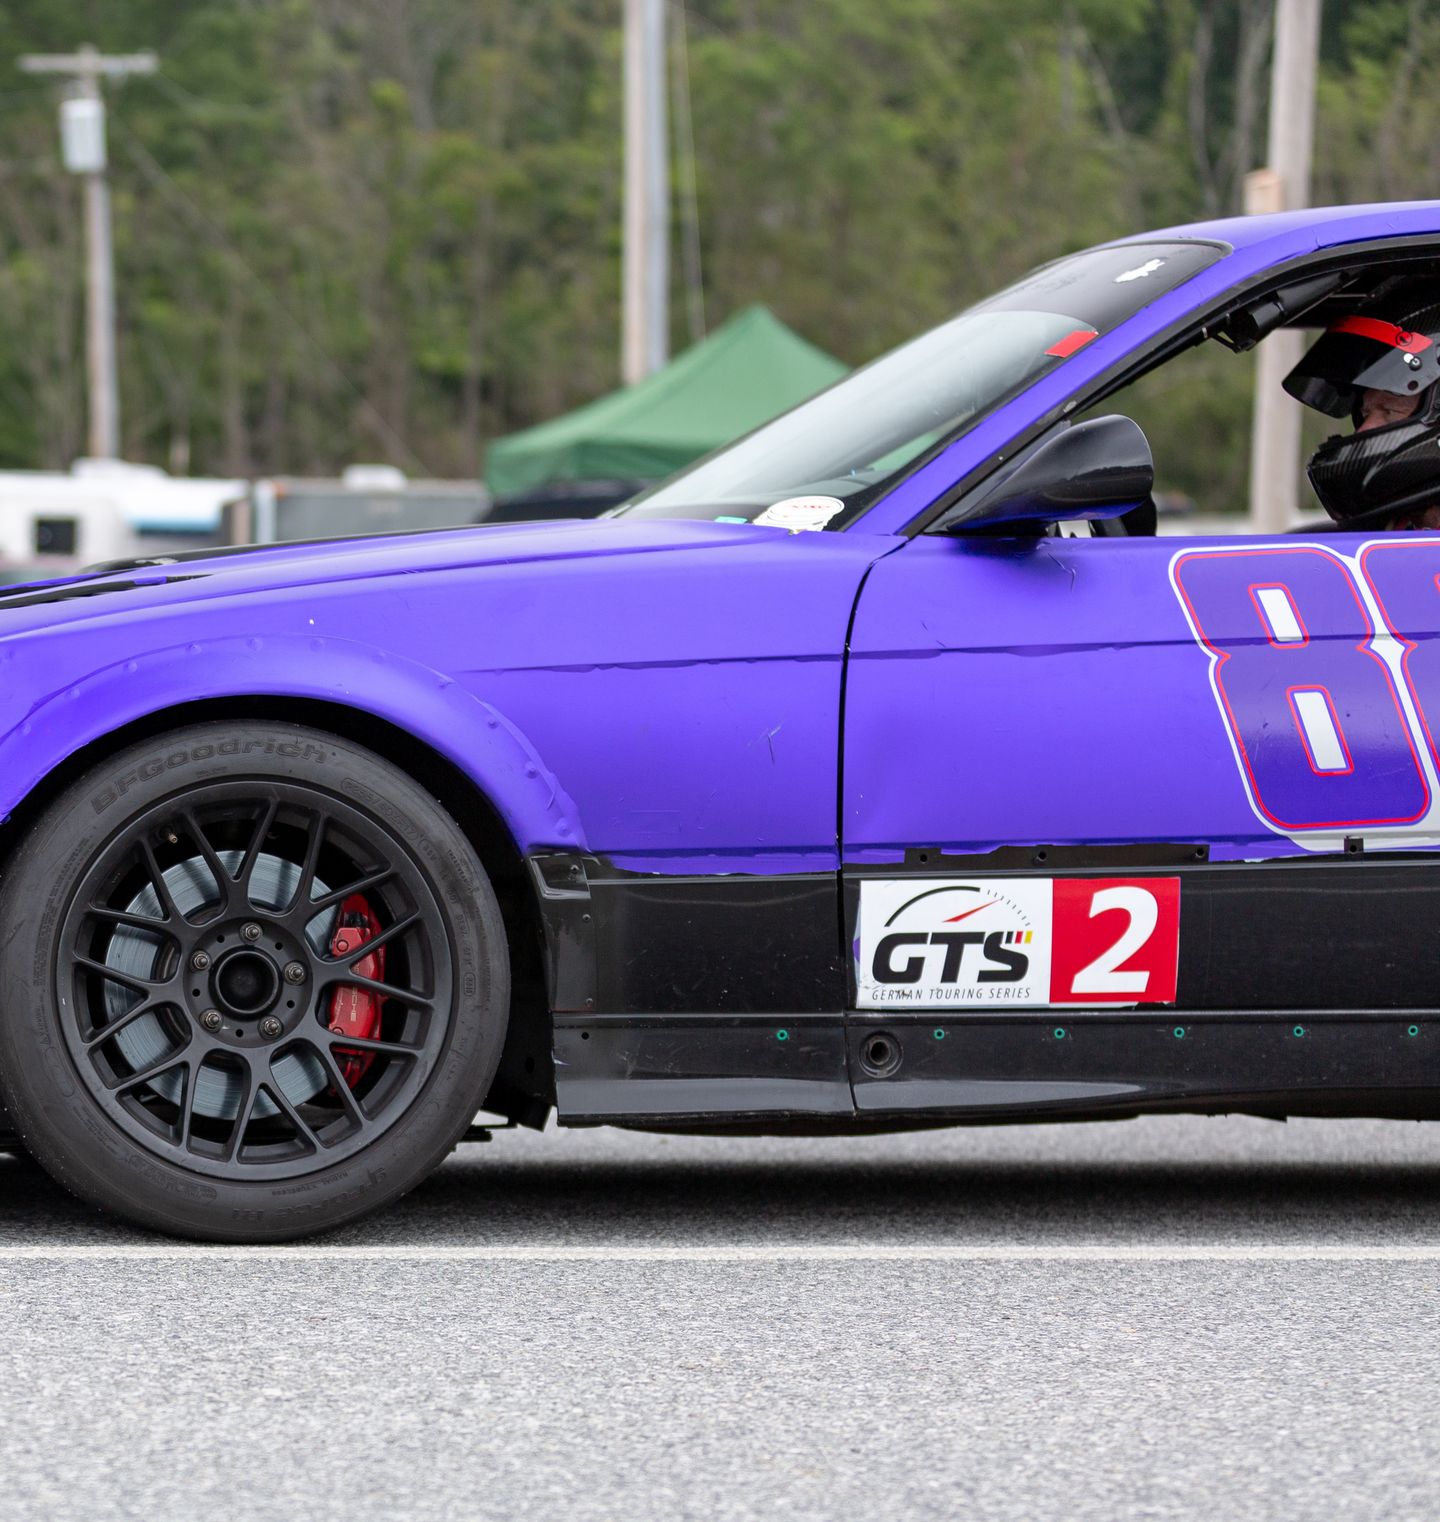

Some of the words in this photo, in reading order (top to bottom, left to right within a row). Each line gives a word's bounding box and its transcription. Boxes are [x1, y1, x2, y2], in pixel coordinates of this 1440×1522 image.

[90, 738, 328, 815] BFGoodrich
[872, 930, 1032, 984] GTS
[1070, 885, 1158, 994] 2
[872, 988, 923, 1001] GERMAN
[929, 987, 984, 1000] TOURING
[988, 987, 1031, 999] SERIES
